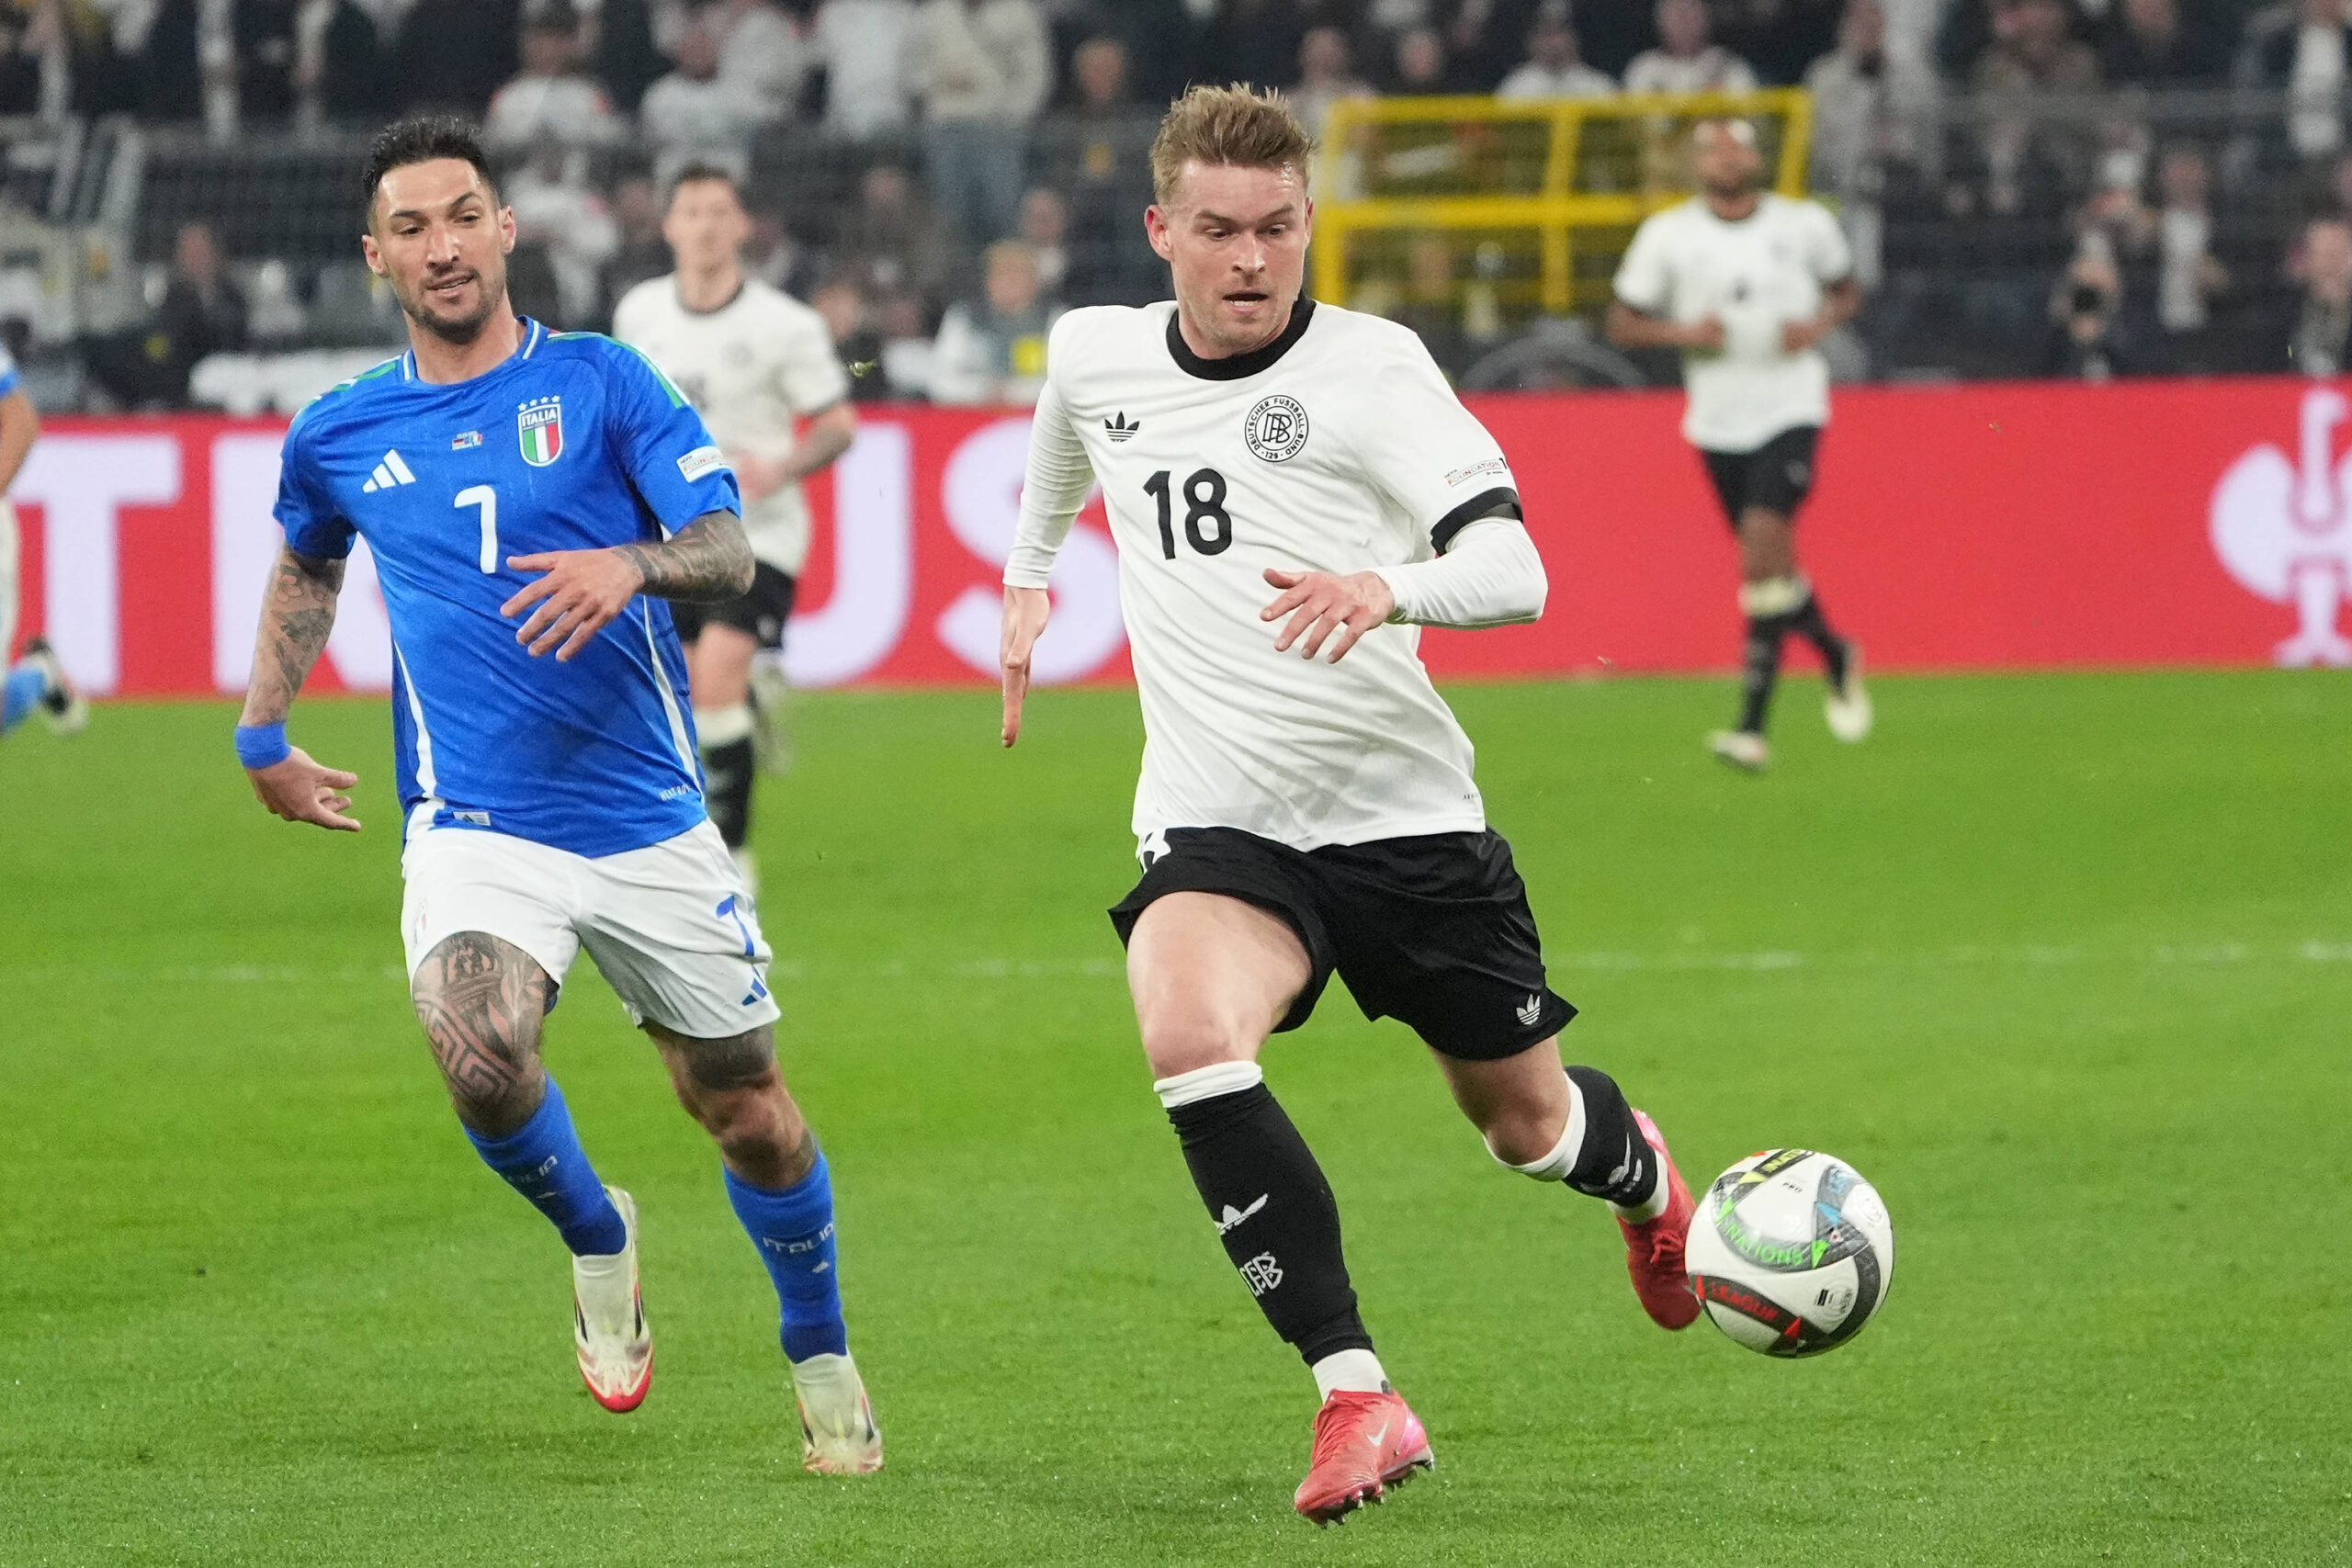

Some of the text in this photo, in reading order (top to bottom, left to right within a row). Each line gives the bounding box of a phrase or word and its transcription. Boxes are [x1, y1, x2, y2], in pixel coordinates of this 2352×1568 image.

[521, 408, 557, 427] ITALIA
[1248, 400, 1270, 451] DEUTSCHER
[454, 484, 498, 574] 7
[1142, 468, 1232, 559] 18
[1725, 1223, 1803, 1265] NATIONS
[1711, 1282, 1779, 1321] LEAGUE
